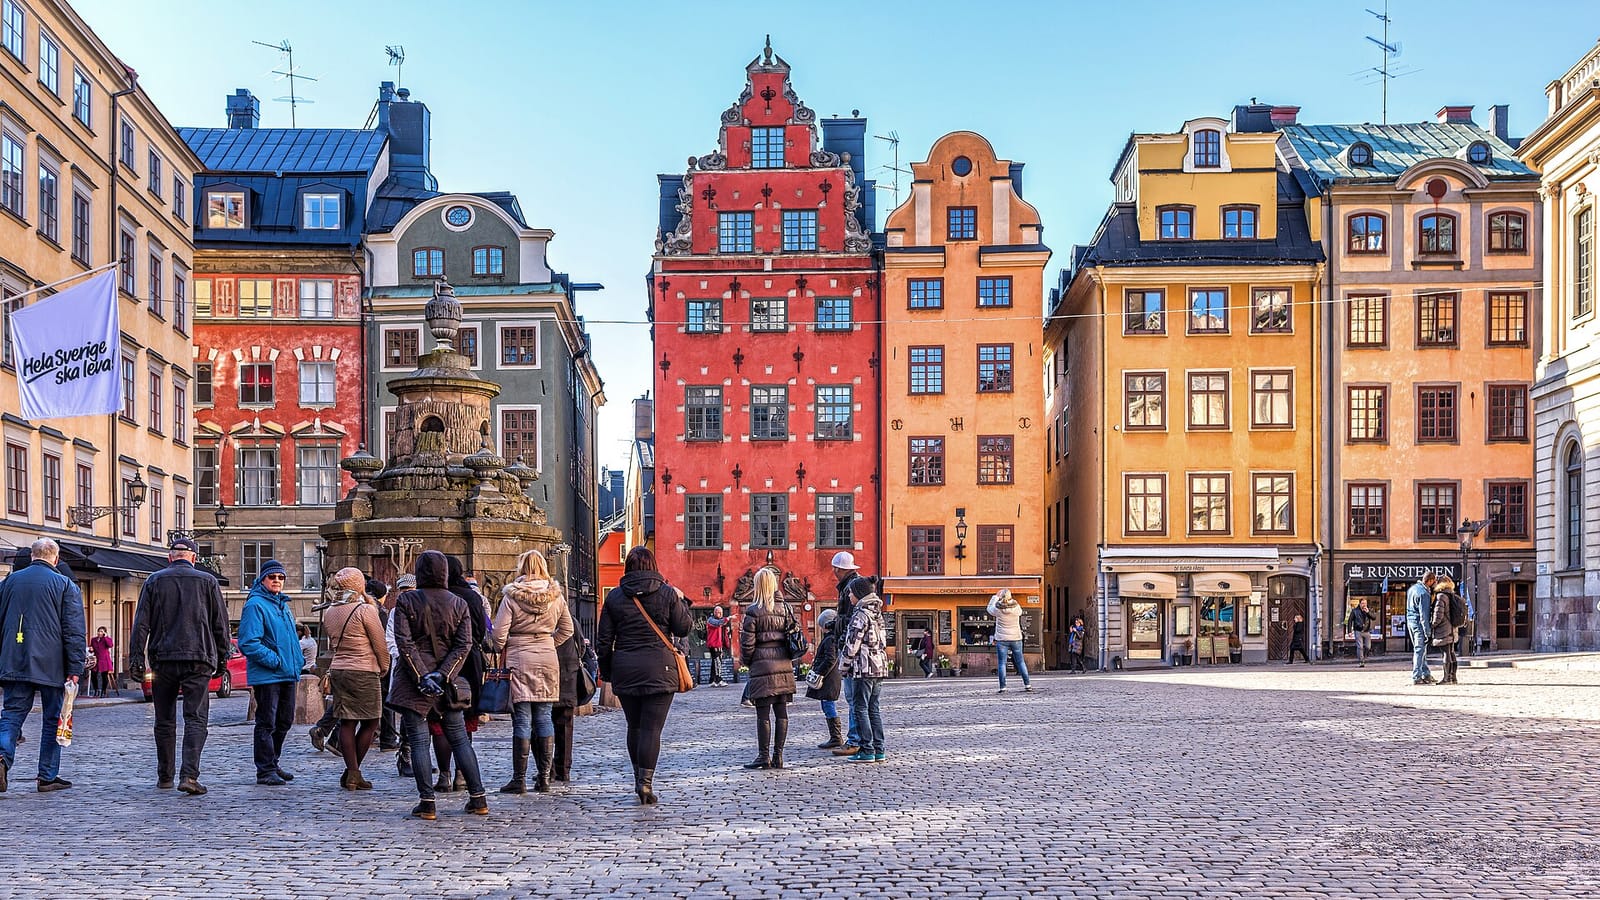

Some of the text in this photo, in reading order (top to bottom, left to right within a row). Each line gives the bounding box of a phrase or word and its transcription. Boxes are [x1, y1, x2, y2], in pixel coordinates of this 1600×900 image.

[23, 341, 107, 377] Hela Sverige
[55, 349, 115, 385] ska leva!
[1367, 566, 1455, 578] RUNSTENEN
